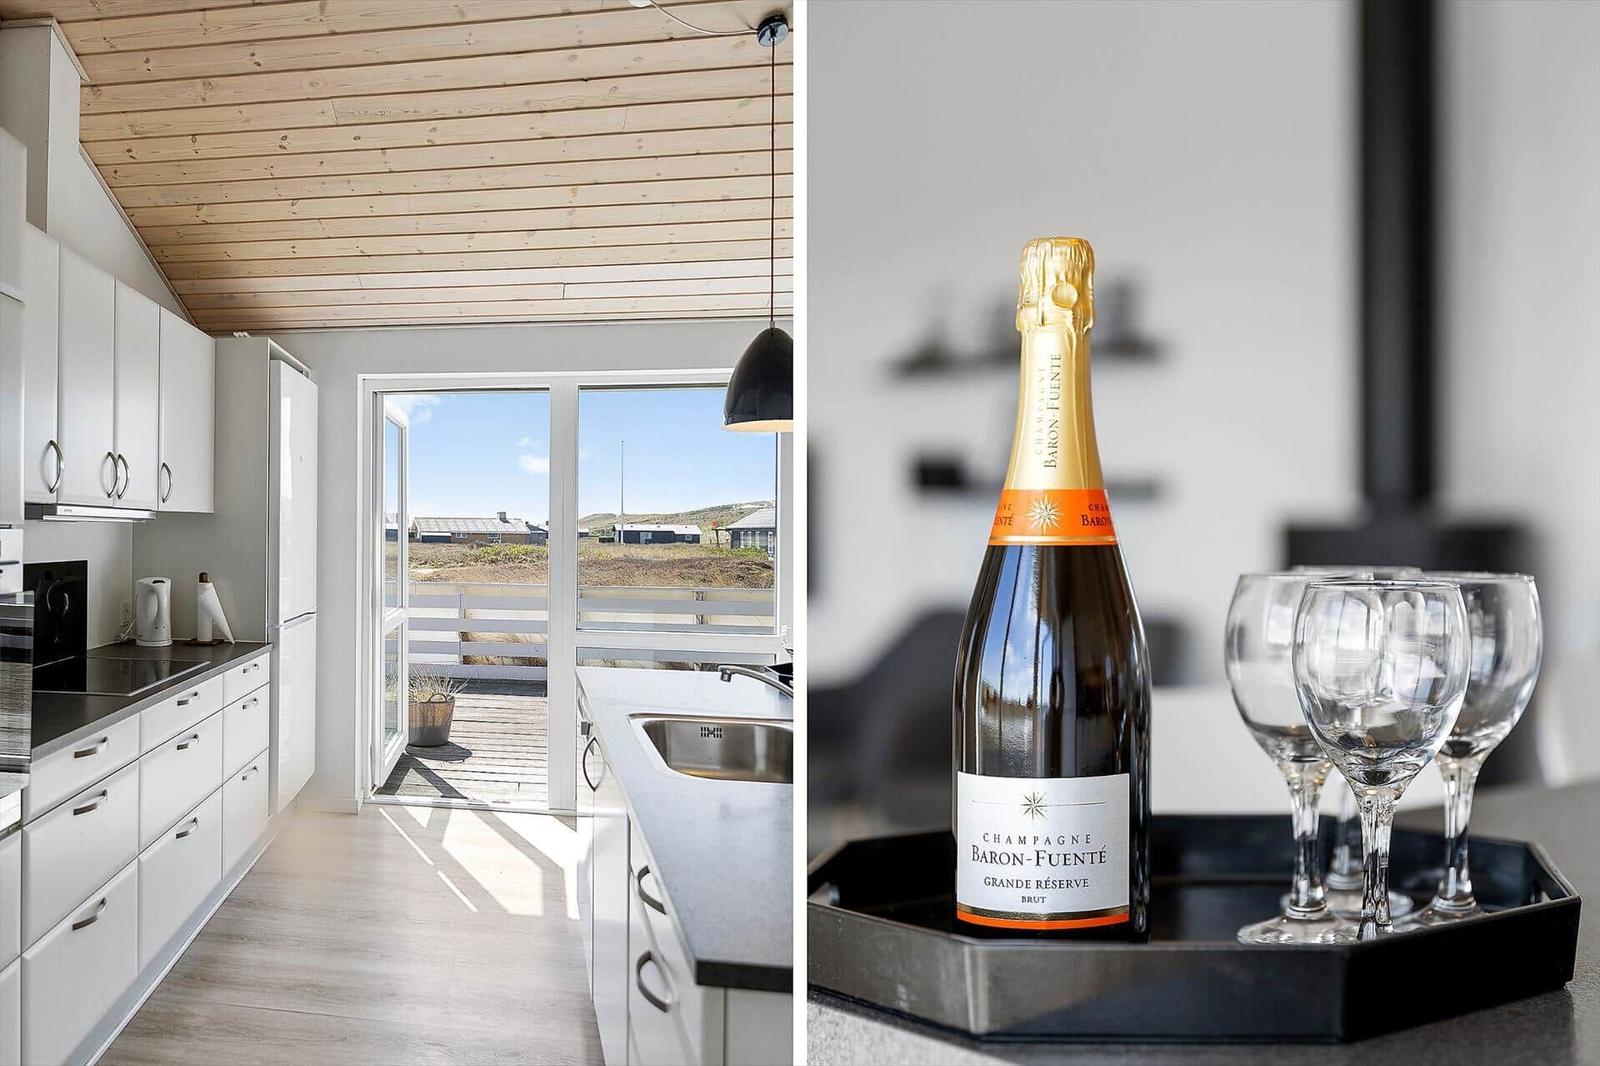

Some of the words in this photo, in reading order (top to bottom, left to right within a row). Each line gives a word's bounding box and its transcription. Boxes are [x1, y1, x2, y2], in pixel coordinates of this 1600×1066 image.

[983, 832, 1092, 846] CHAMPAGNE
[971, 844, 1107, 867] BARON-FUENTÉ
[984, 876, 1031, 889] GRANDE
[1035, 876, 1089, 889] RÉSERVE
[1021, 896, 1046, 904] BRUT
